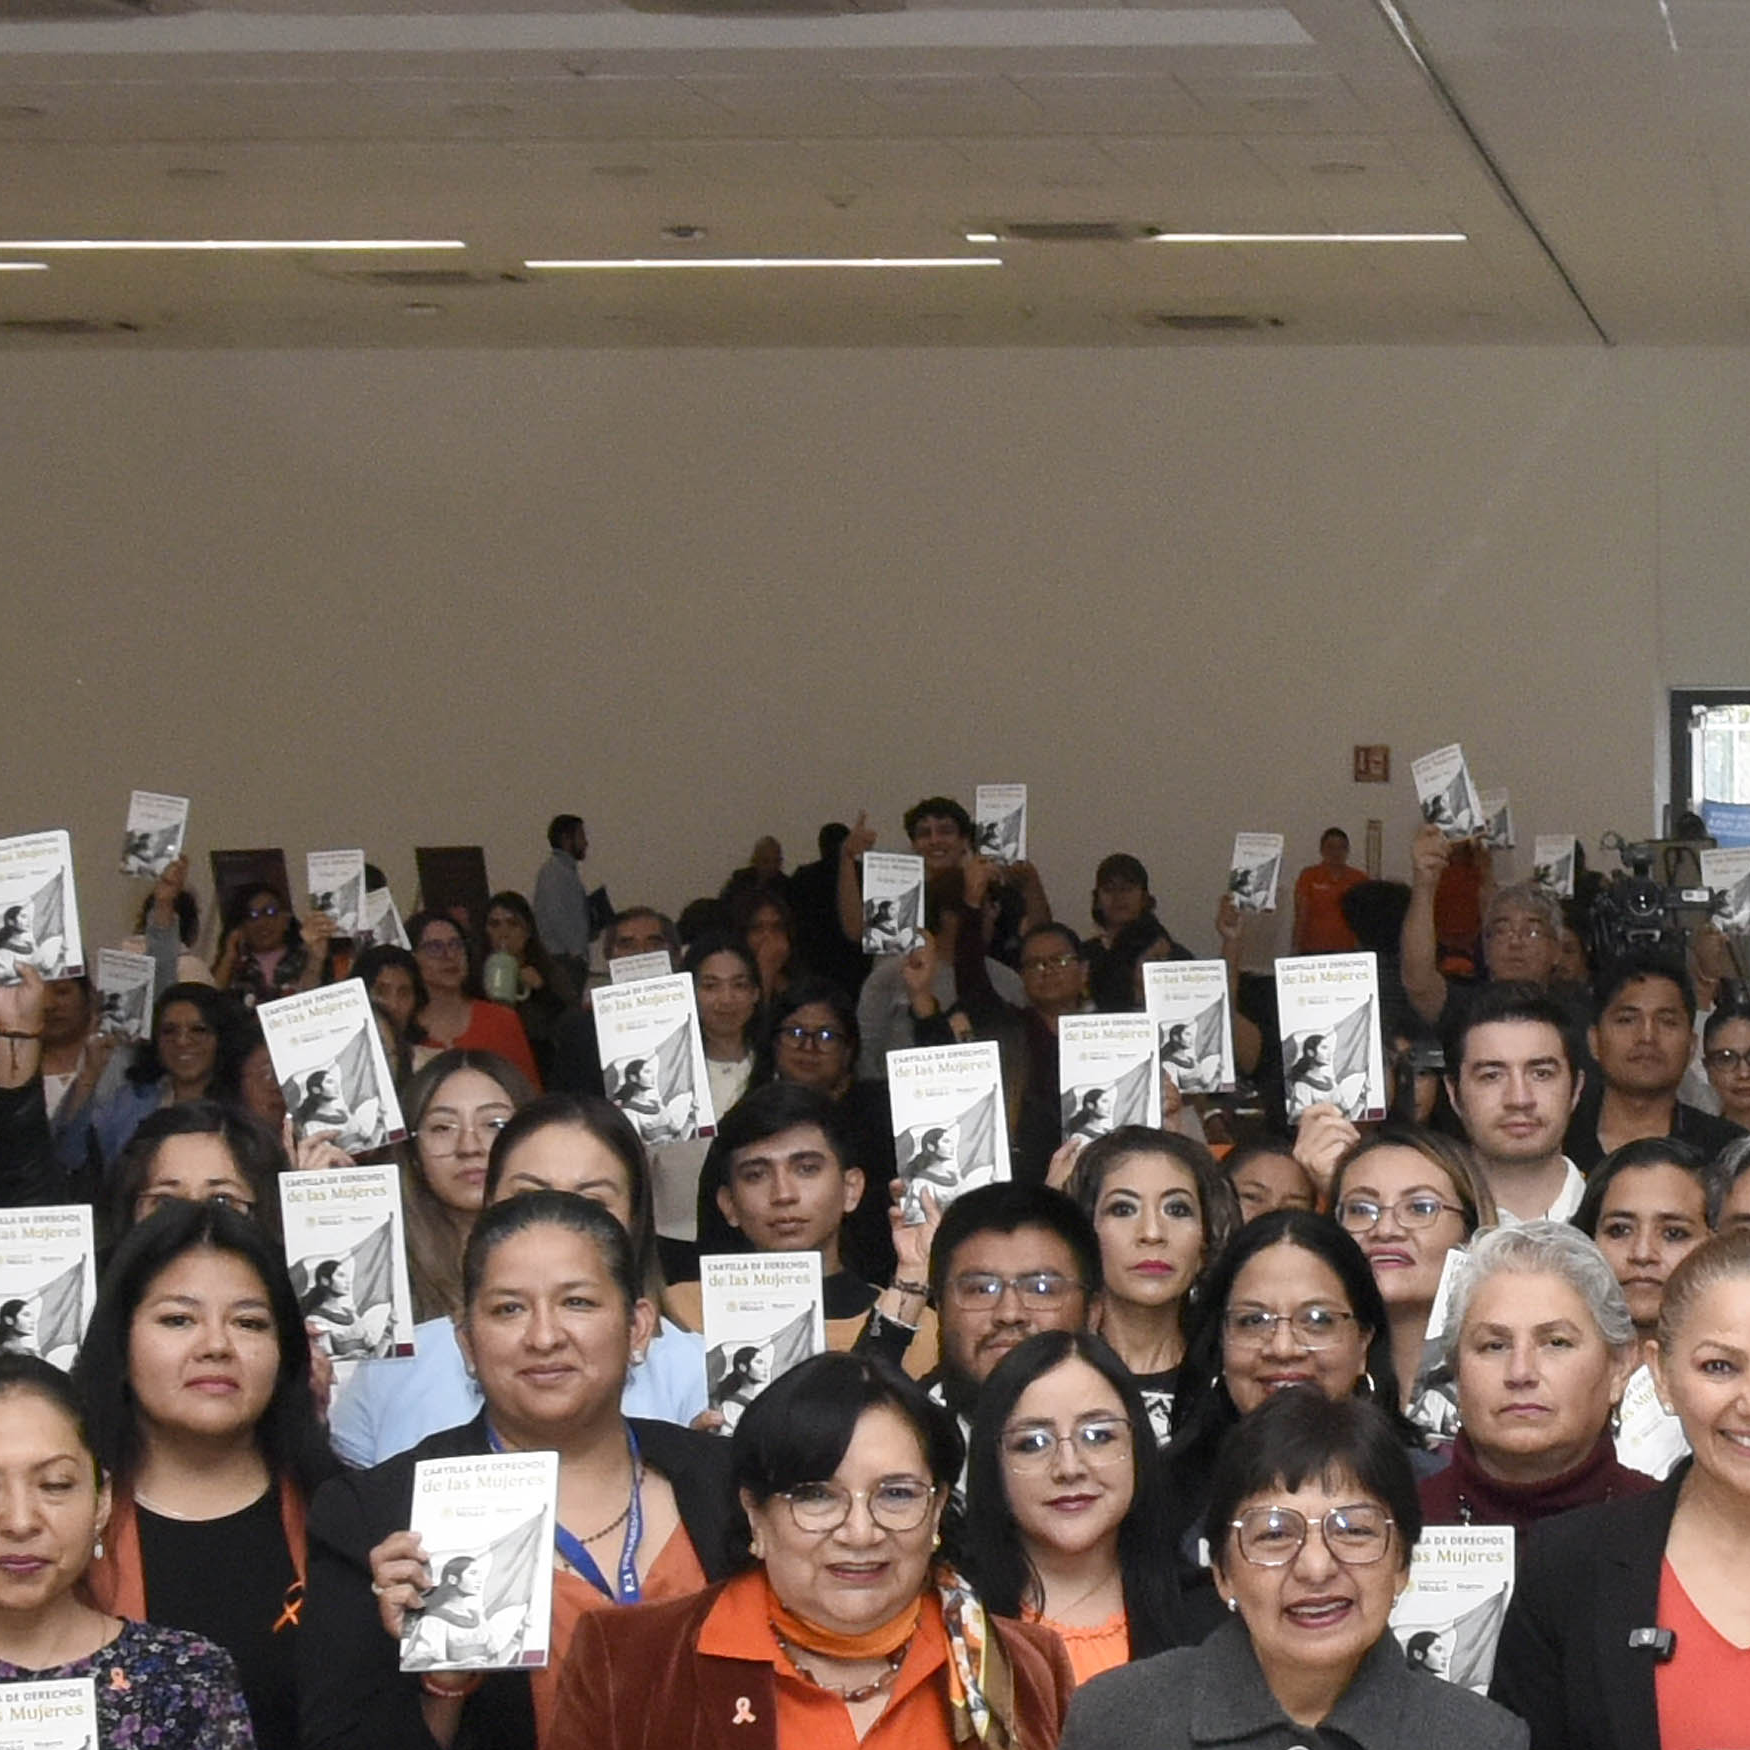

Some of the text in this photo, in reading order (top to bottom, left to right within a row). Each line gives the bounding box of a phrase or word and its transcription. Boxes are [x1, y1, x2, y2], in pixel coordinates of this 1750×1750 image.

[1281, 970, 1368, 985] de las Mujeres
[894, 1060, 991, 1078] de las Mujeres
[285, 1185, 384, 1204] de las Mujeres
[19, 1216, 29, 1225] DE
[21, 1226, 81, 1241] Mujeres
[707, 1261, 809, 1272] CARTILLA DE DERECHOS
[708, 1272, 810, 1288] de las Mujeres
[422, 1465, 472, 1477] CARTILLA
[475, 1464, 487, 1473] DE
[422, 1474, 545, 1493] de las Mujeres
[1434, 1536, 1505, 1546] DE DERECHOS
[1411, 1551, 1504, 1565] as Mujeres
[6, 1693, 19, 1704] DE
[23, 1688, 82, 1703] DERECHOS
[9, 1704, 83, 1722] Mujeres
